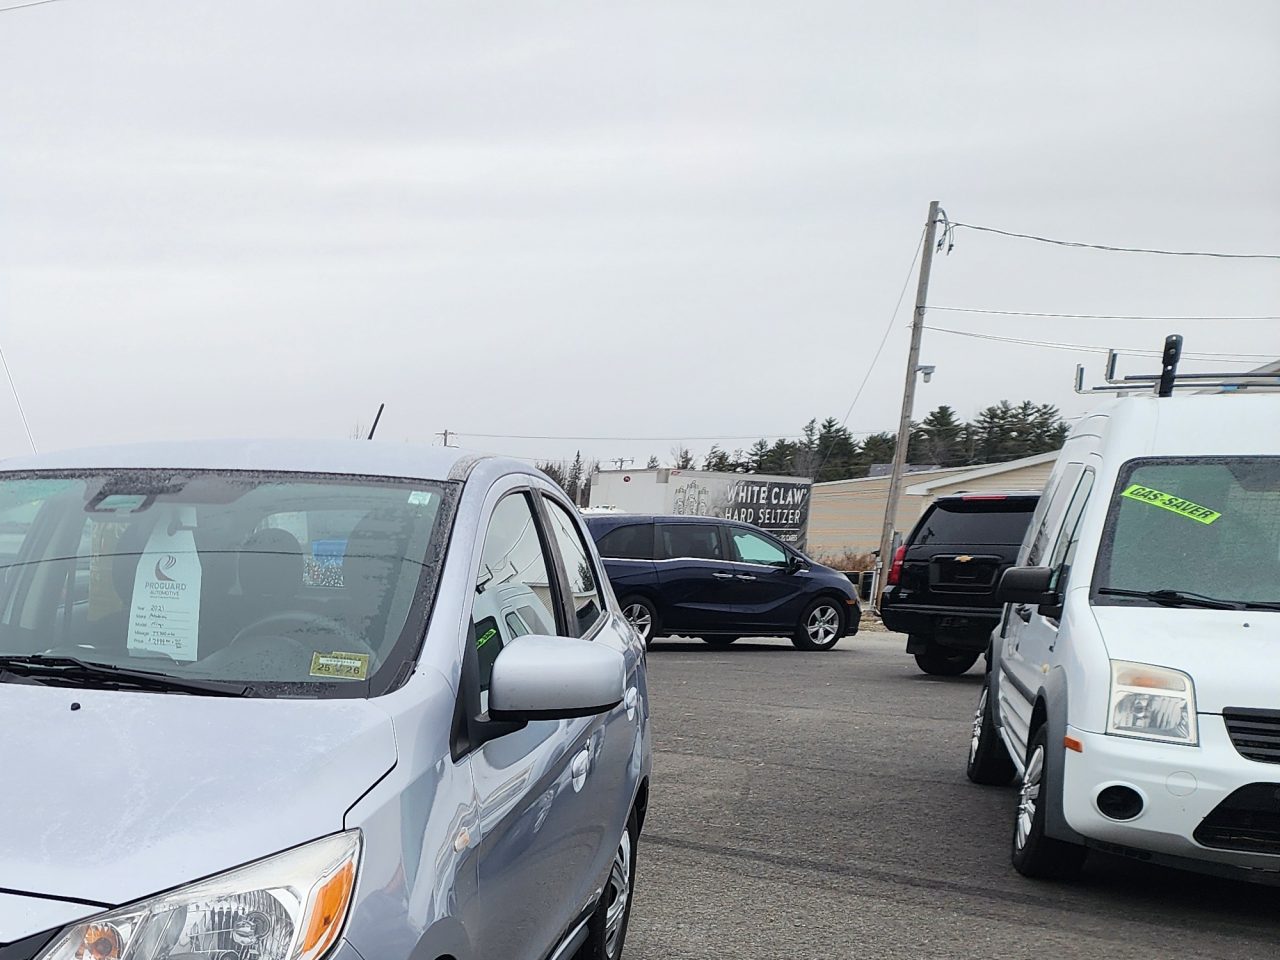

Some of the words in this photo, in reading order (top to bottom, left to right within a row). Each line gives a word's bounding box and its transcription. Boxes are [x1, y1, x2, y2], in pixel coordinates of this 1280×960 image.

[727, 485, 768, 504] WHITE
[771, 487, 804, 505] CLAW
[725, 508, 754, 523] HARD
[758, 509, 801, 524] SELTZER
[145, 582, 187, 591] PROGUARD
[317, 664, 331, 672] 25
[344, 666, 360, 675] 26
